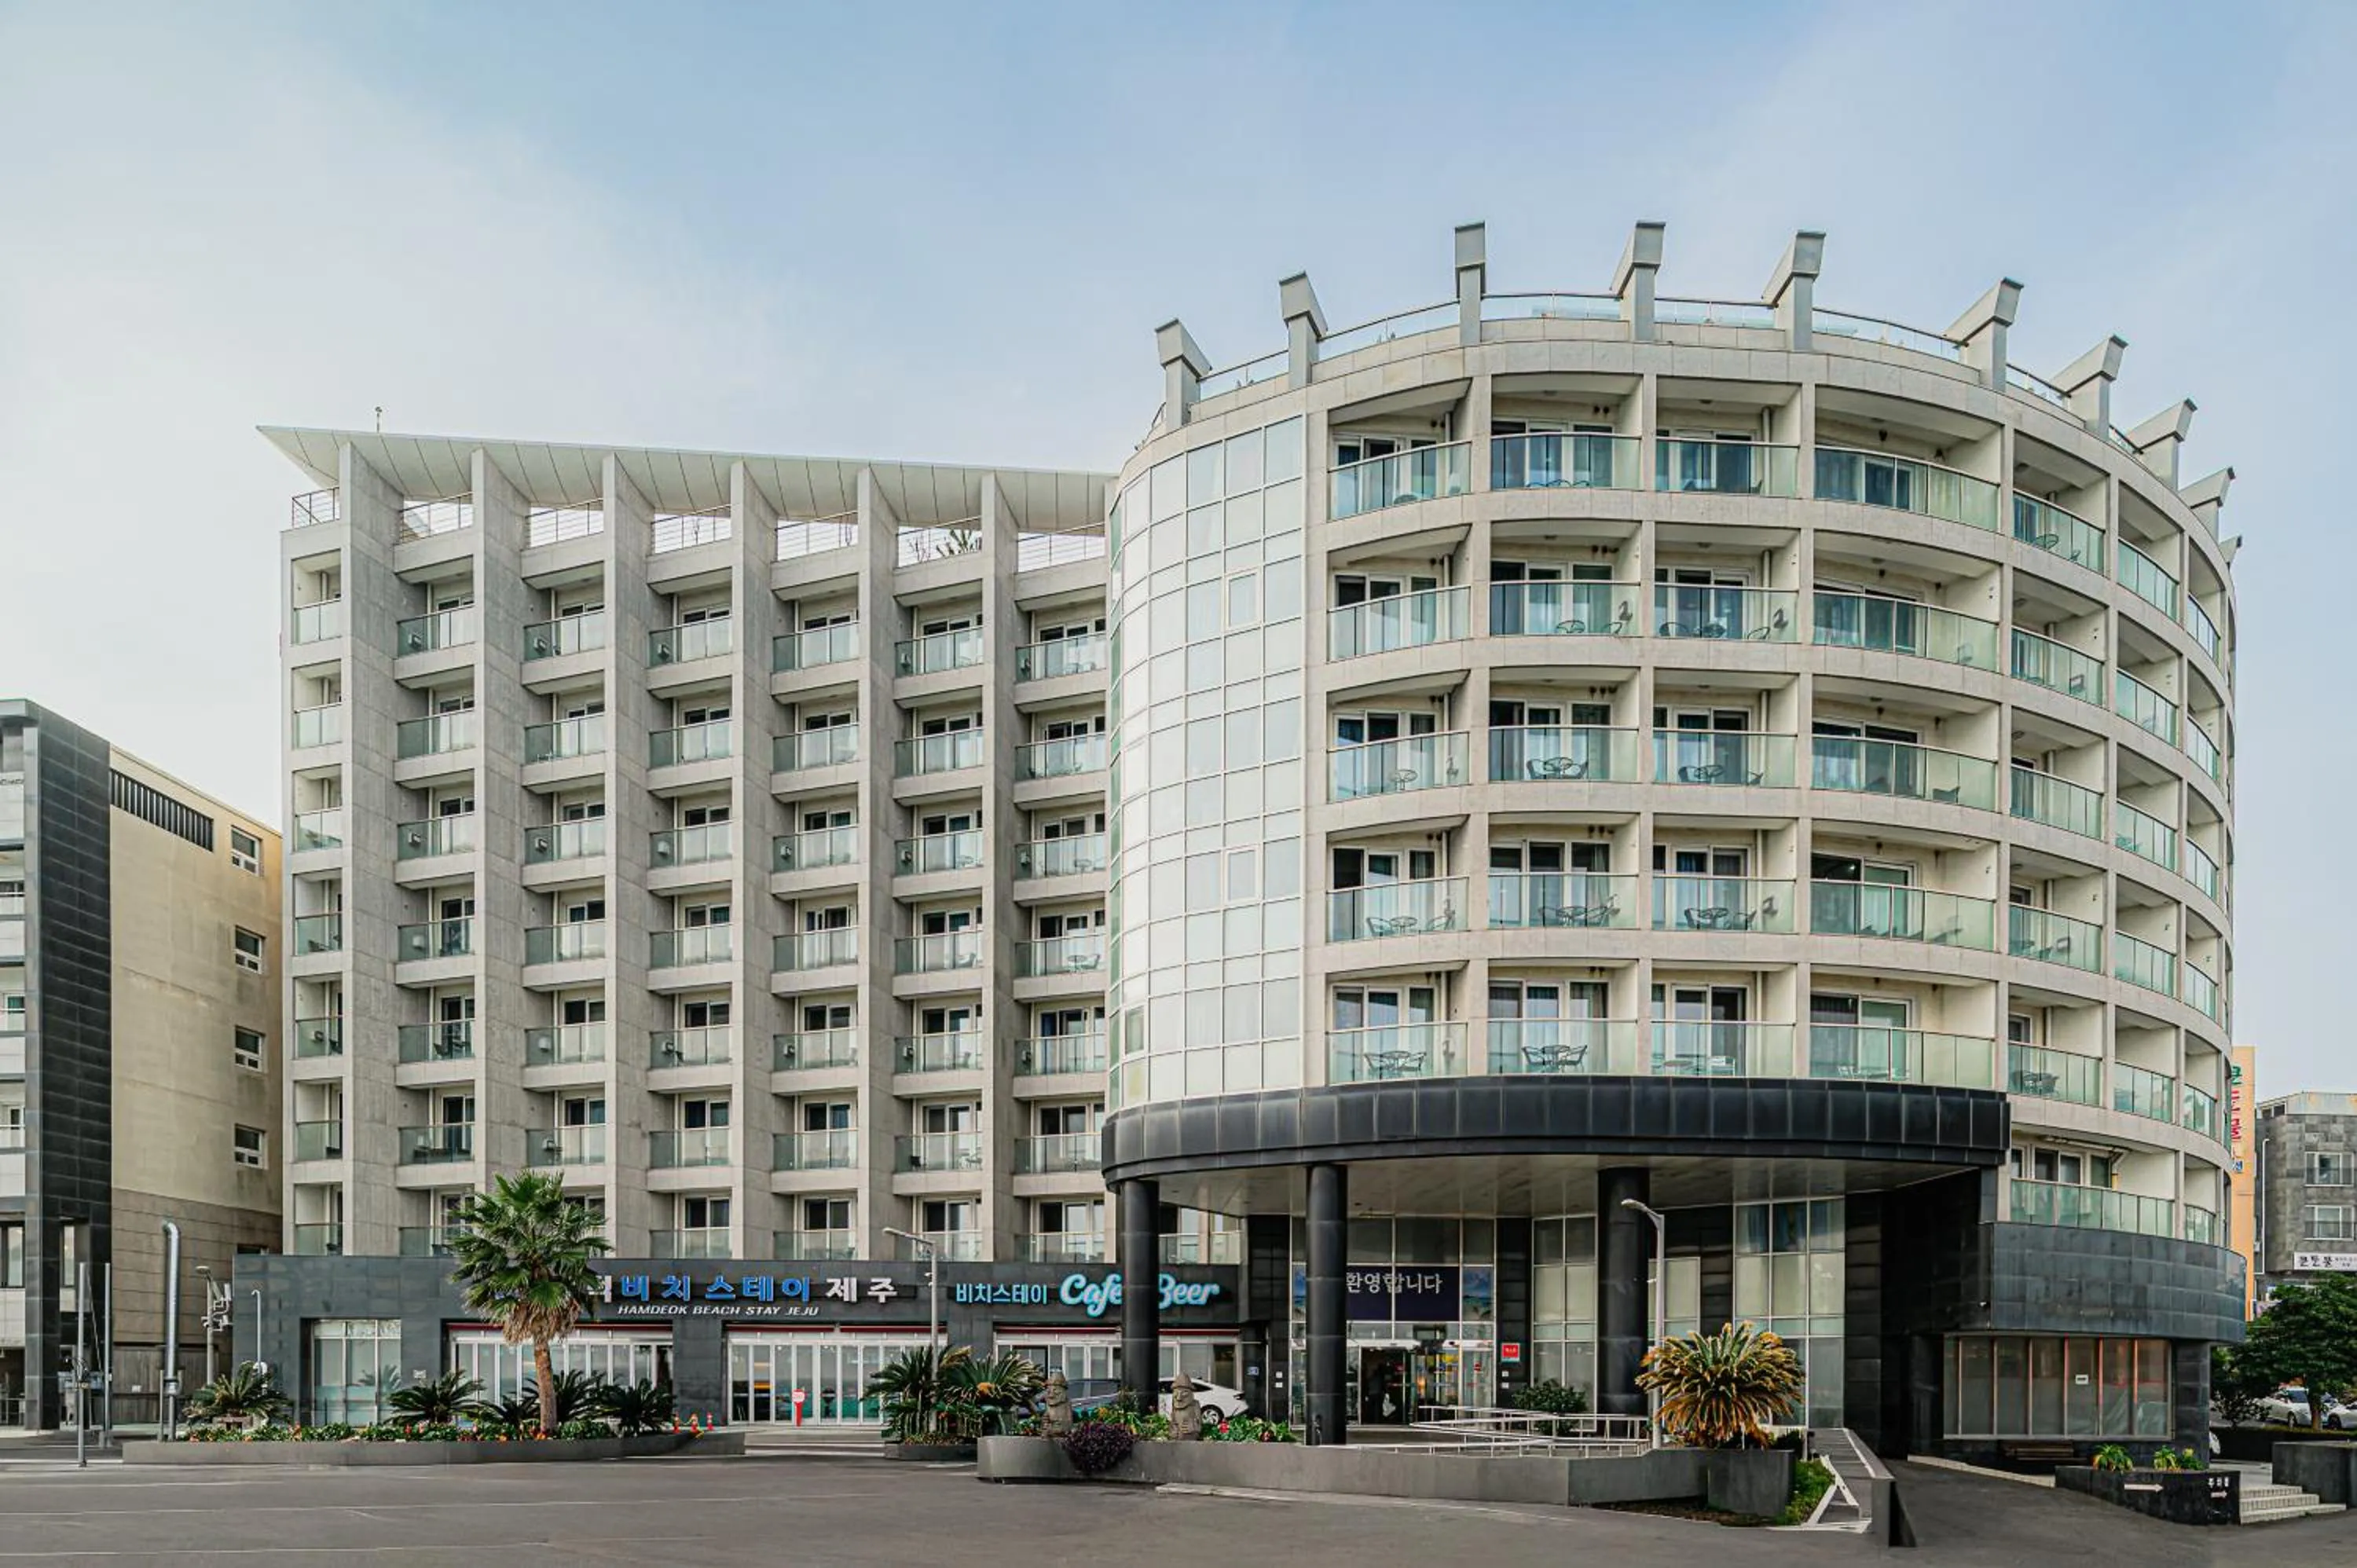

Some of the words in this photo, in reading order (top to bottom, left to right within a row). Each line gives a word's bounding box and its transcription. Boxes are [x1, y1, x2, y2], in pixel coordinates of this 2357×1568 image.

[826, 1277, 898, 1303] 제주
[955, 1283, 1048, 1305] 비치스테이
[1158, 1273, 1220, 1310] Beer
[1346, 1272, 1443, 1294] 환영합니다
[618, 1305, 687, 1314] HAMDEOK
[692, 1306, 740, 1315] BEACH
[746, 1306, 781, 1316] STAY
[785, 1306, 819, 1316] JEJU
